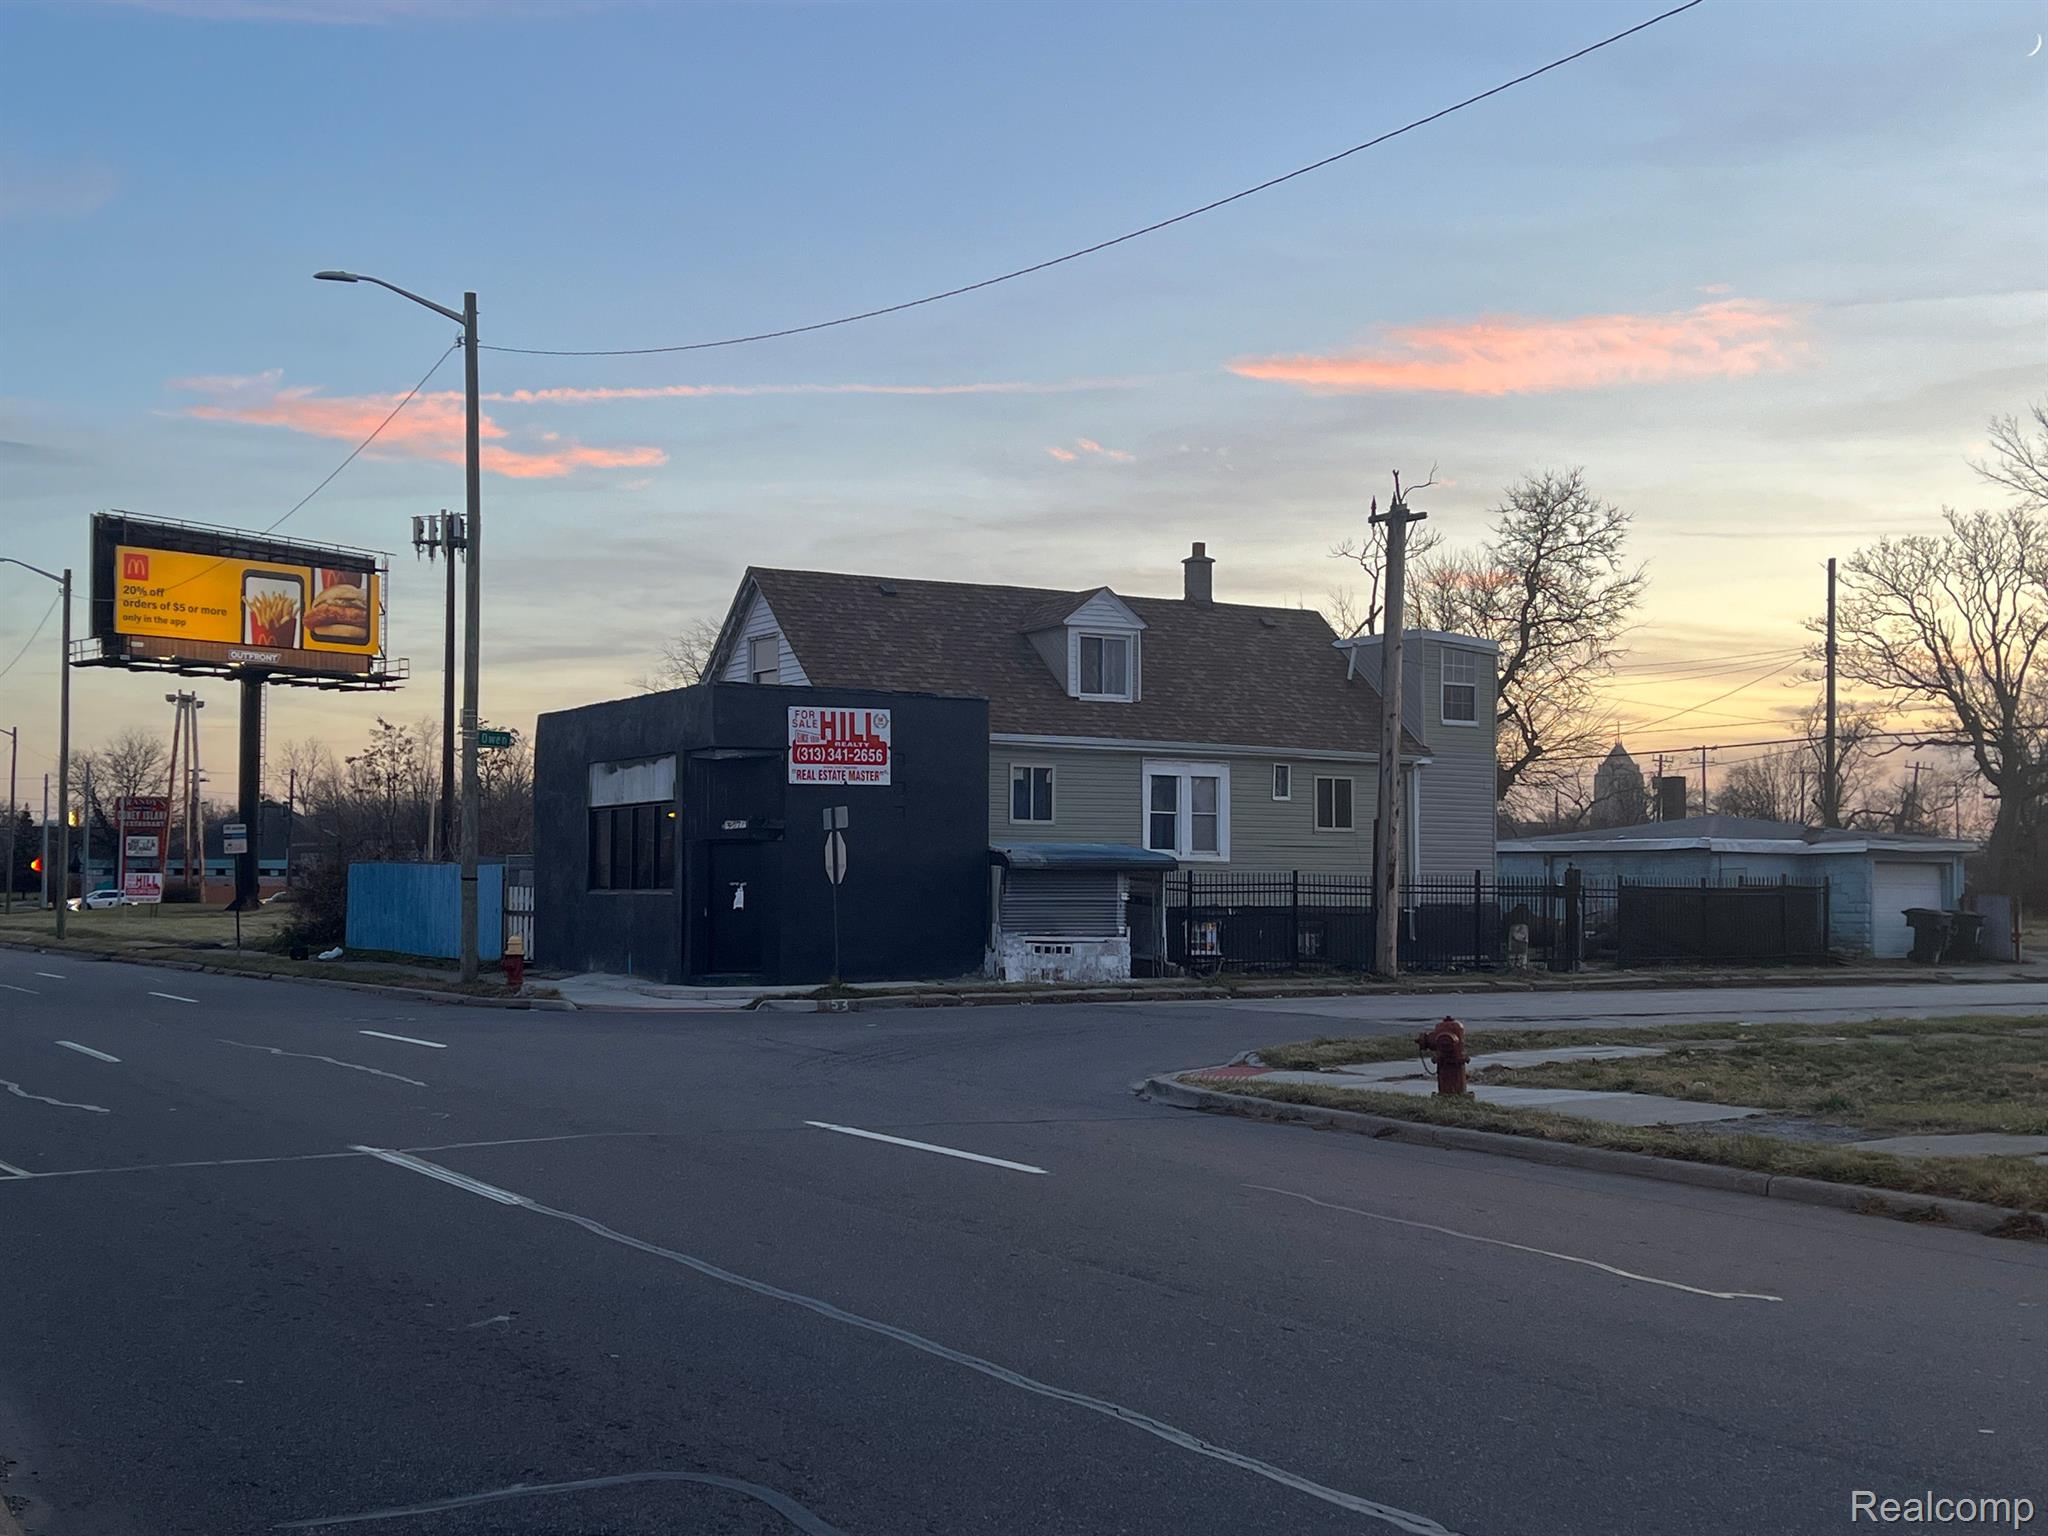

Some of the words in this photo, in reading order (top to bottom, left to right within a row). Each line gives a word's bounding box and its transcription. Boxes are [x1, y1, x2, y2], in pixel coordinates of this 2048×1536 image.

[123, 585, 147, 597] 20%
[149, 588, 165, 597] off
[123, 599, 157, 610] orders
[160, 602, 170, 611] of
[173, 602, 186, 612] $5
[188, 605, 198, 613] or
[201, 606, 228, 616] more
[123, 613, 142, 624] only
[143, 614, 152, 623] in
[154, 616, 168, 625] the
[170, 618, 187, 628] app
[792, 719, 818, 729] SALE
[794, 710, 815, 719] FOR
[820, 711, 880, 741] HILL
[481, 733, 508, 745] Owen
[796, 747, 826, 762] (313)
[827, 748, 883, 762] 341-2656
[818, 769, 846, 781] ESTATE
[136, 874, 158, 888] HILL
